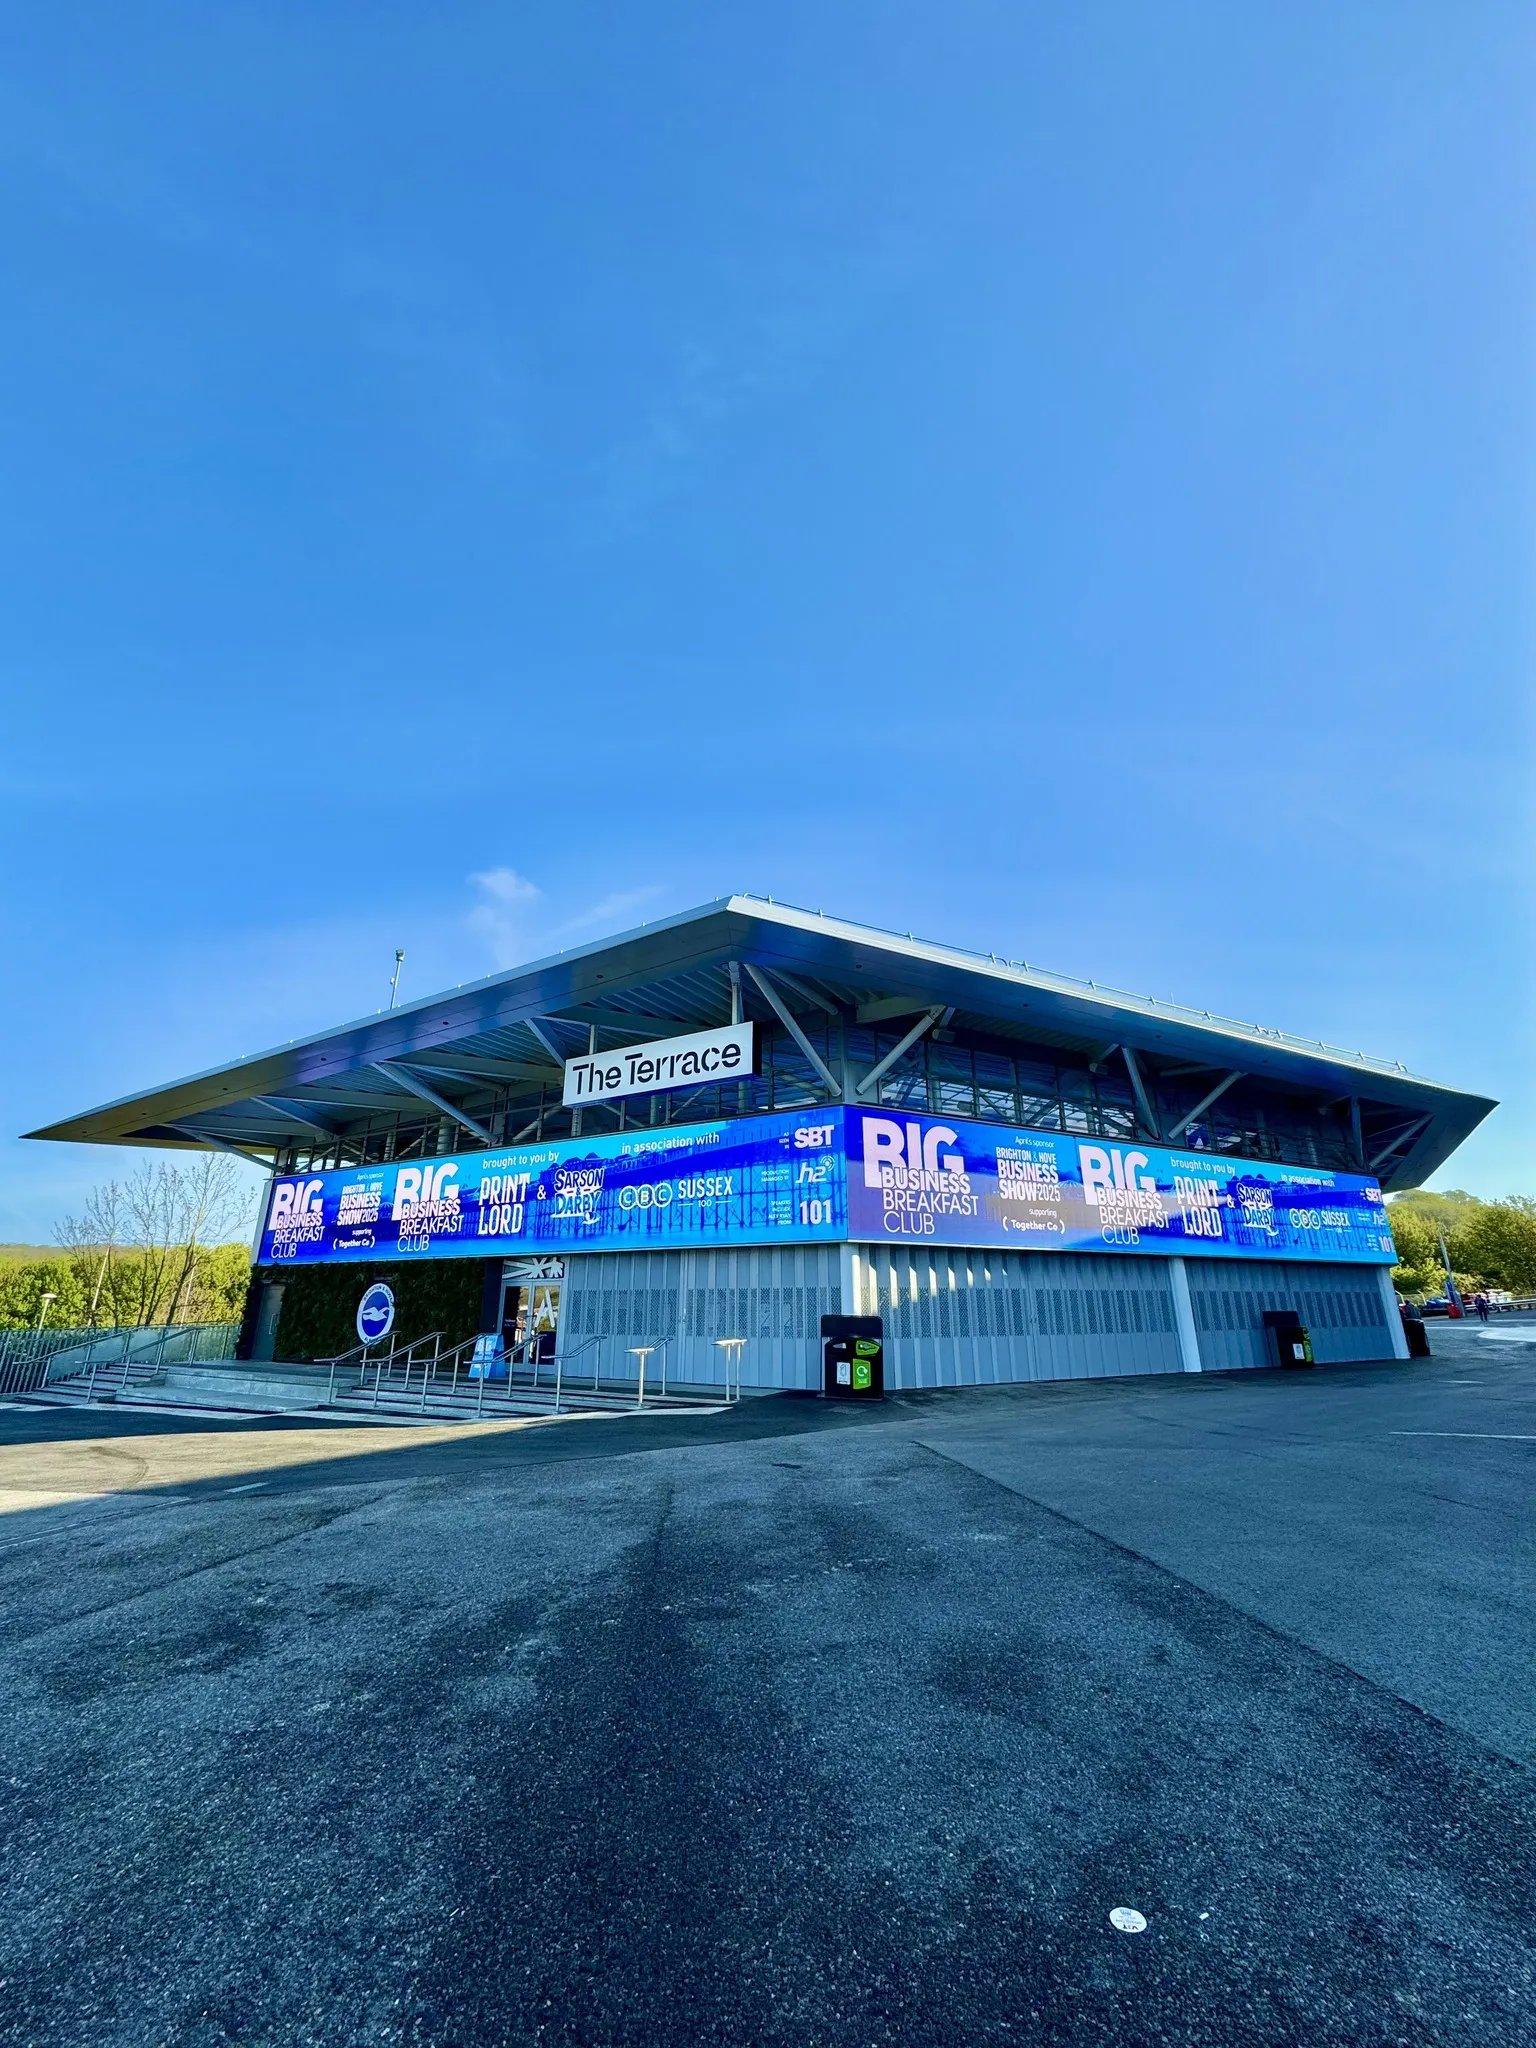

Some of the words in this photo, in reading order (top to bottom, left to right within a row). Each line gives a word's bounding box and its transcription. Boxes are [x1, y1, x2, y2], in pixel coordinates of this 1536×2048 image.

[572, 1062, 622, 1095] The
[625, 1043, 741, 1085] Terrace
[622, 1143, 631, 1154] in
[633, 1136, 693, 1153] association
[696, 1132, 720, 1146] with
[794, 1125, 835, 1149] SBT
[1032, 1139, 1055, 1148] sponsor
[482, 1155, 517, 1170] brought
[519, 1154, 528, 1165] to
[529, 1153, 546, 1166] you
[548, 1150, 560, 1163] by
[862, 1116, 965, 1188] BIG
[996, 1146, 1032, 1162] BRIGHTON
[1032, 1152, 1038, 1163] &
[1038, 1151, 1057, 1164] HOVE
[795, 1162, 827, 1184] h2
[997, 1158, 1059, 1184] BUSINESS
[1079, 1145, 1157, 1206] BIG
[1170, 1156, 1202, 1172] brought
[1202, 1161, 1211, 1171] to
[1211, 1164, 1226, 1175] you
[1226, 1164, 1235, 1176] by
[478, 1172, 531, 1206] PRINT
[554, 1168, 605, 1191] SARSON
[678, 1176, 733, 1200] SUSSEX
[881, 1166, 971, 1195] BUSINESS
[999, 1179, 1037, 1202] SHOW
[1037, 1184, 1061, 1202] 2025
[1280, 1172, 1288, 1182] in
[1288, 1174, 1321, 1186] association
[1321, 1179, 1336, 1187] with
[340, 1192, 381, 1210] BUSINESS
[391, 1162, 460, 1221] BIG
[537, 1185, 546, 1200] &
[882, 1188, 979, 1216] BREAKFAST
[1096, 1187, 1163, 1210] BUSINESS
[1173, 1175, 1219, 1207] PRINT
[1226, 1194, 1235, 1208] &
[1236, 1182, 1273, 1205] SARSON
[268, 1179, 324, 1230] BIG
[401, 1198, 461, 1219] BUSINESS
[554, 1190, 603, 1216] DARBY
[697, 1199, 712, 1208] 100
[800, 1199, 832, 1225] 101
[1028, 1208, 1057, 1219] supporting
[276, 1211, 324, 1230] BUSINESS
[337, 1209, 361, 1226] SHOW
[361, 1208, 379, 1223] 2025
[399, 1215, 465, 1236] BREAKFAST
[477, 1203, 523, 1235] LORD
[883, 1210, 935, 1235] CLUB
[1010, 1219, 1046, 1232] Together
[1046, 1221, 1058, 1231] Co
[1099, 1206, 1170, 1229] BREAKFAST
[1181, 1205, 1223, 1237] LORD
[1241, 1203, 1274, 1227] DARBY
[1321, 1210, 1351, 1226] SUSSEX
[273, 1226, 325, 1243] BREAKFAST
[338, 1239, 361, 1249] Together
[361, 1238, 370, 1246] Co
[351, 1229, 372, 1237] supporting
[397, 1234, 430, 1252] CLUB
[1101, 1225, 1140, 1245] CLUB
[271, 1243, 297, 1258] CLUB
